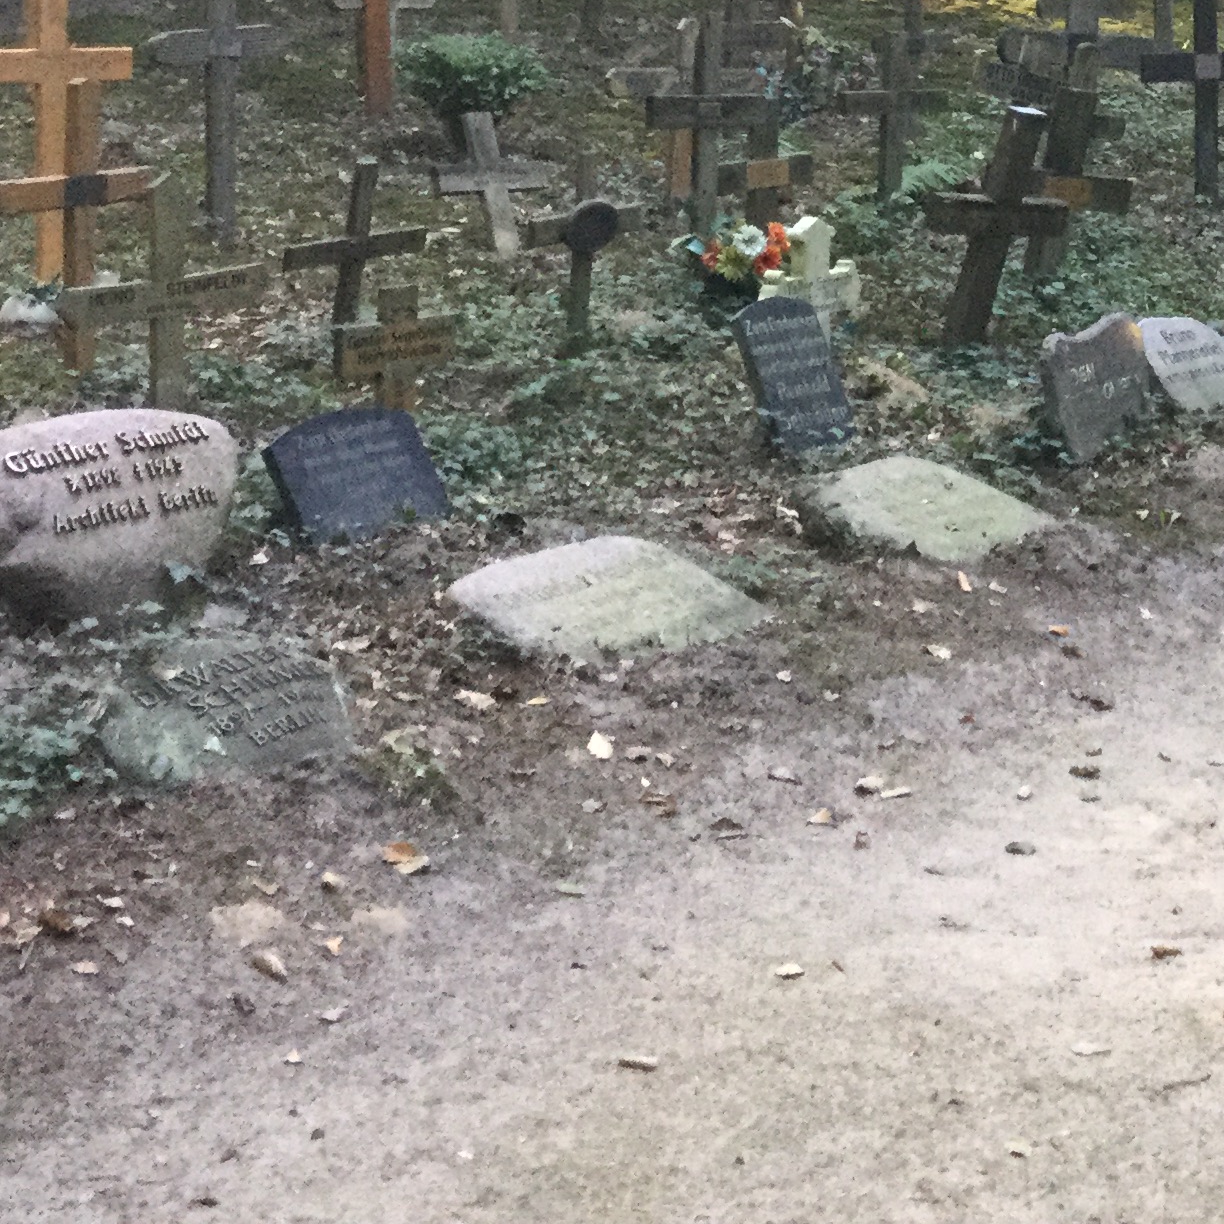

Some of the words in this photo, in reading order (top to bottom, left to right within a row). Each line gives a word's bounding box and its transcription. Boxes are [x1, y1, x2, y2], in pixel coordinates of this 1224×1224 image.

[3, 440, 109, 476] Günther
[115, 421, 210, 456] Schmidt
[53, 495, 151, 534] Architekt
[157, 484, 218, 516] Berlin
[248, 706, 327, 747] BERLIN
